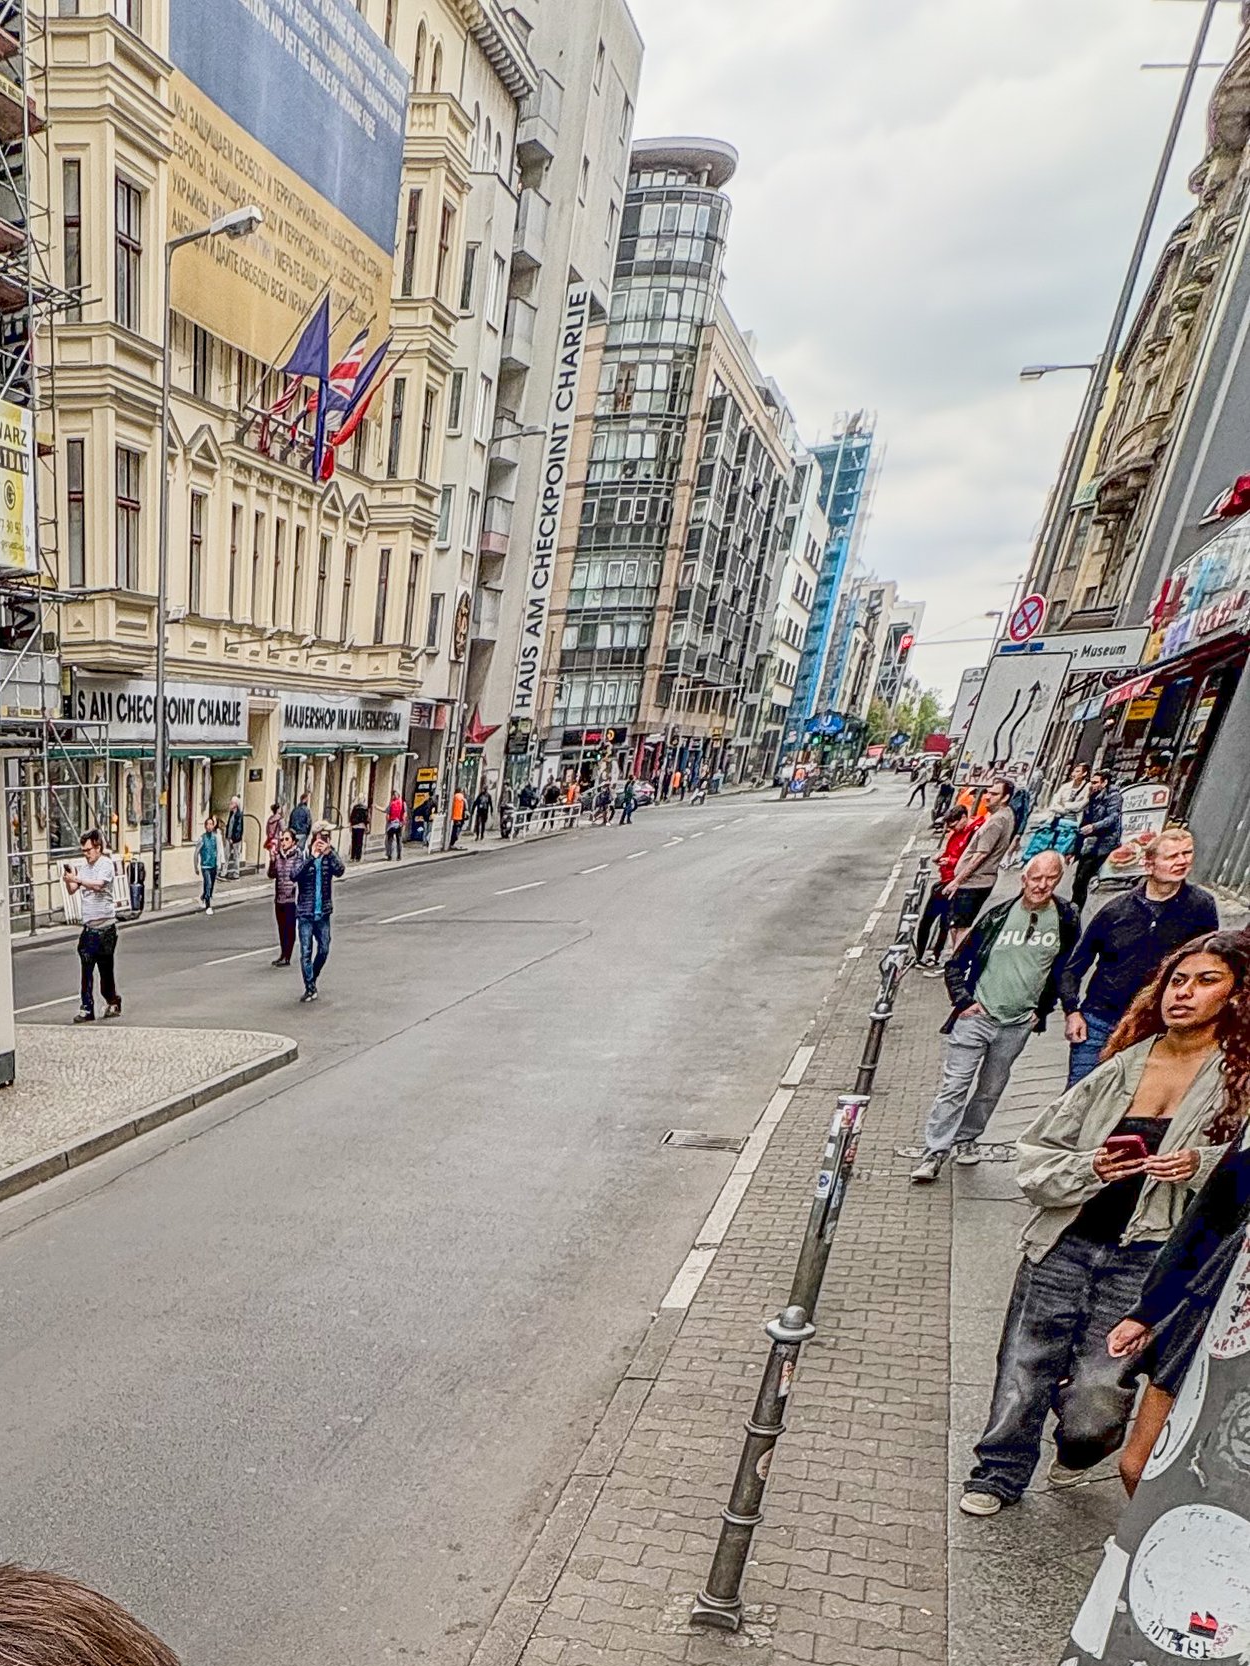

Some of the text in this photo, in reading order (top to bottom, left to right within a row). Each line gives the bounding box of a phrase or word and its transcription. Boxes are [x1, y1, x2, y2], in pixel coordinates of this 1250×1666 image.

[555, 290, 588, 413] CHARLIE
[531, 422, 570, 591] CHECKPOINT
[525, 598, 546, 638] AM
[1080, 644, 1127, 659] Museum
[514, 646, 539, 709] HAUS
[90, 691, 112, 722] AM
[198, 698, 241, 727] CHARLIE
[284, 704, 336, 730] MAUERSHOP
[337, 708, 348, 730] IM
[996, 930, 1057, 947] HUGO
